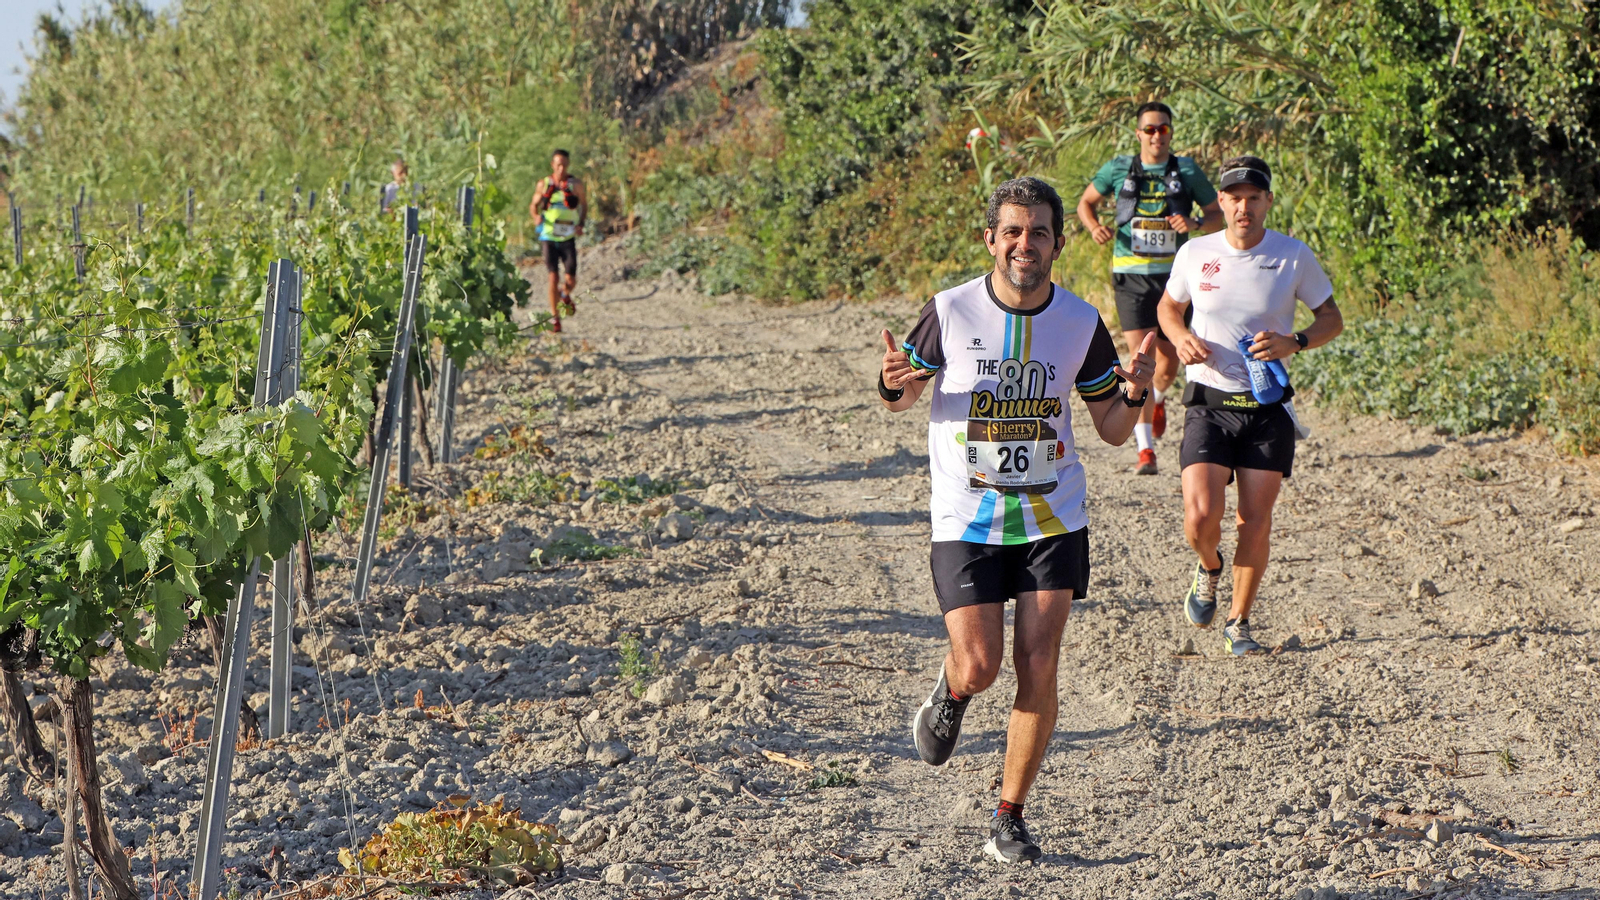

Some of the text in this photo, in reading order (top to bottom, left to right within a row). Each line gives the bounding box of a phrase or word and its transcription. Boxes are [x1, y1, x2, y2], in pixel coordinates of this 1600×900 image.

[1144, 233, 1166, 246] 189
[976, 359, 998, 375] THE
[968, 390, 1062, 418] Runner
[992, 421, 1036, 437] Sherry
[997, 445, 1029, 473] 26
